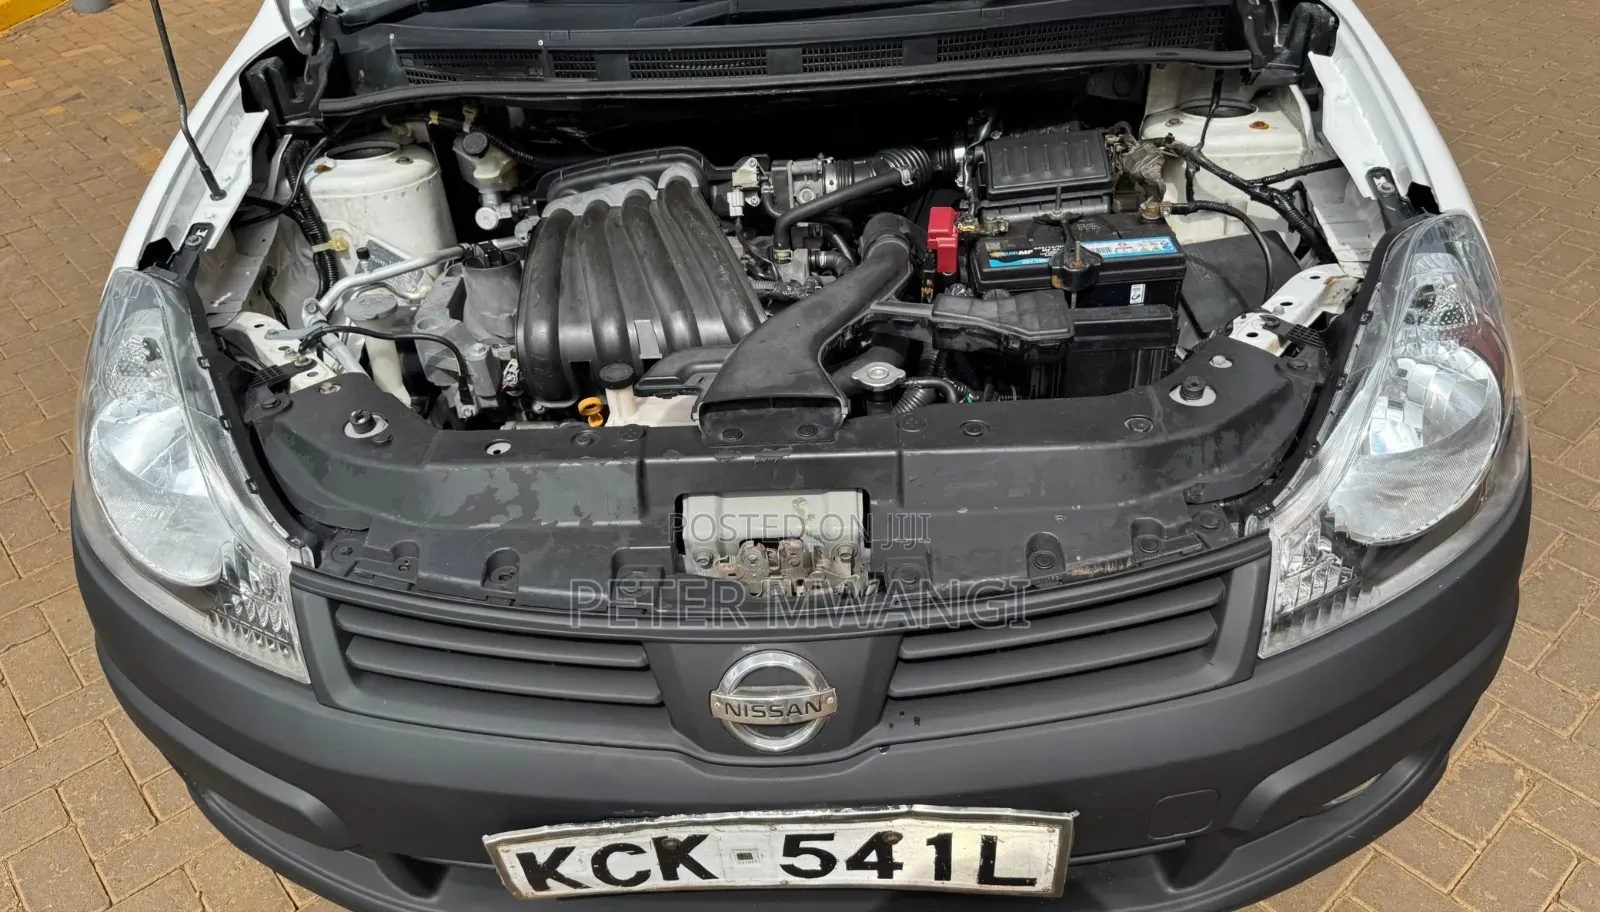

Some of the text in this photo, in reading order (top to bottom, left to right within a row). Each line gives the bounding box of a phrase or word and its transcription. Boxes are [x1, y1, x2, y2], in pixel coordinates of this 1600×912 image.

[724, 699, 823, 719] NISSAN
[515, 831, 1037, 892] KCK 541L
